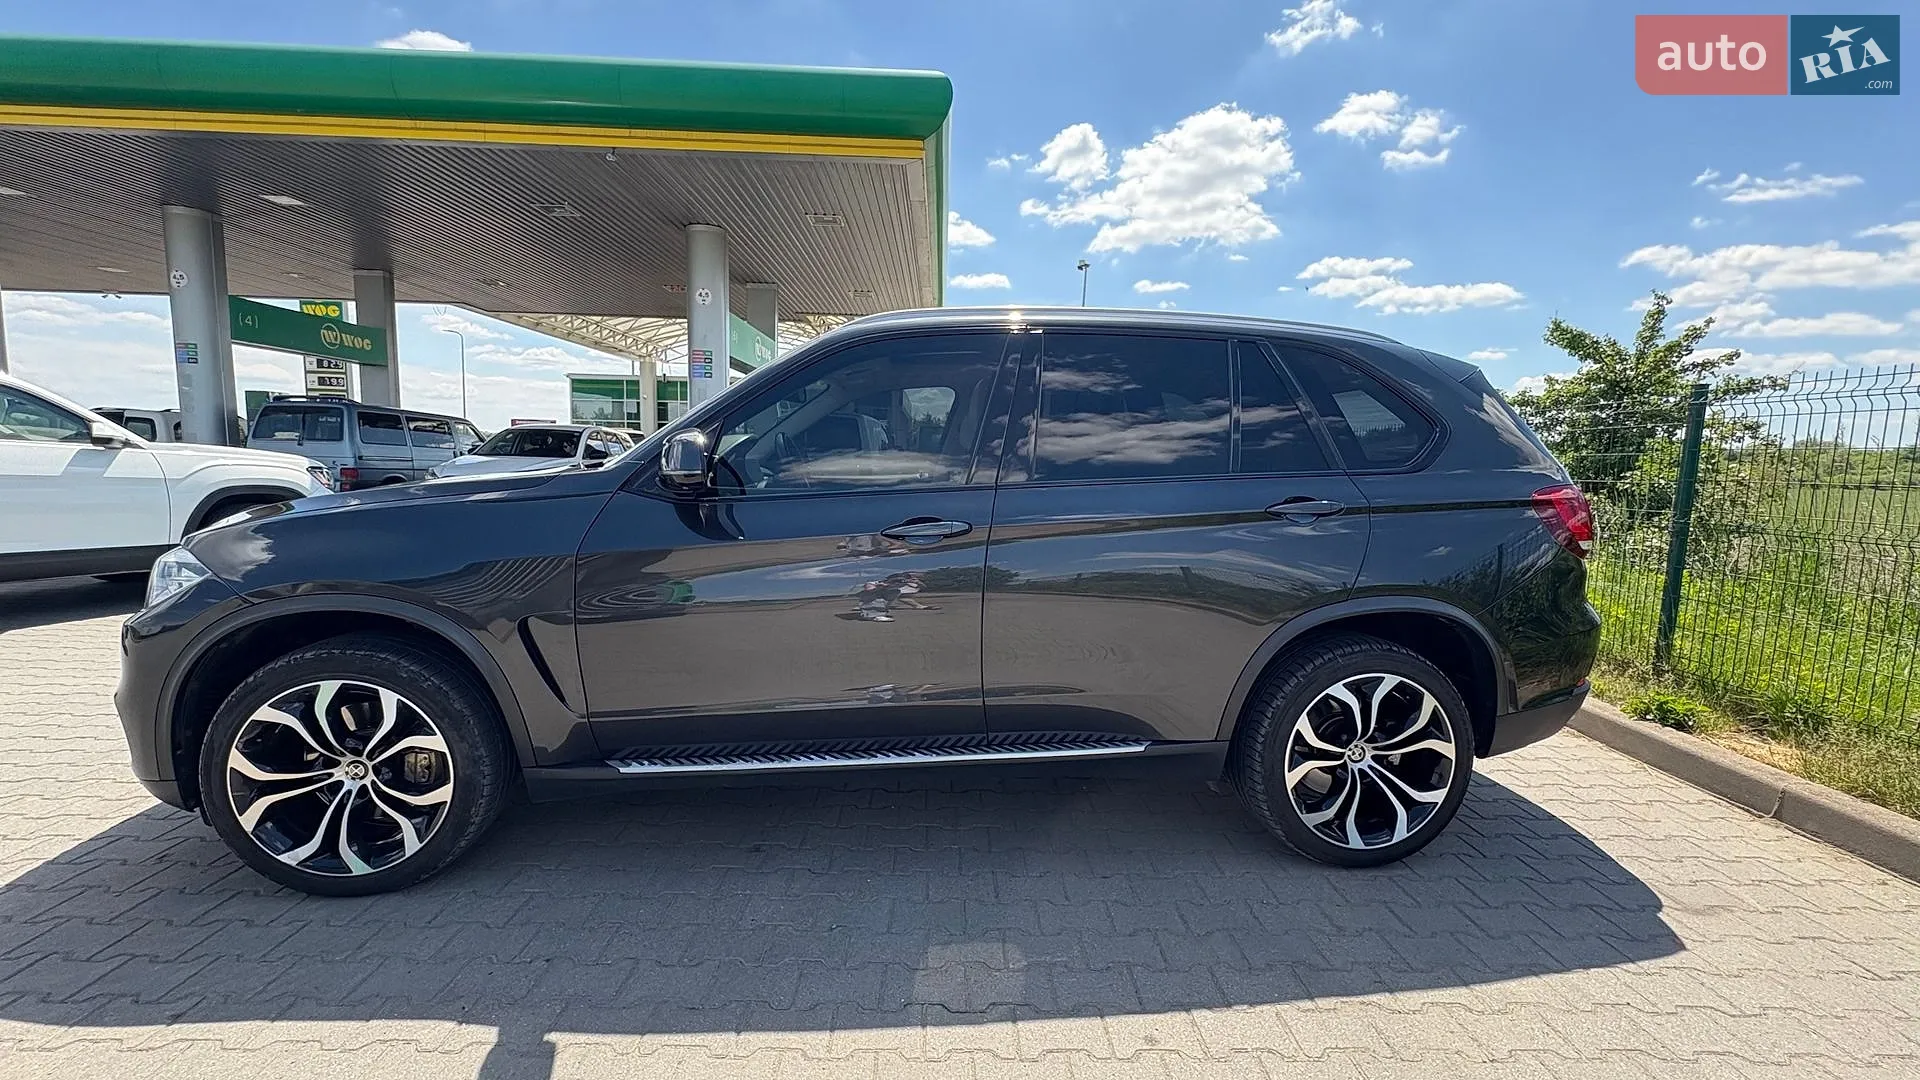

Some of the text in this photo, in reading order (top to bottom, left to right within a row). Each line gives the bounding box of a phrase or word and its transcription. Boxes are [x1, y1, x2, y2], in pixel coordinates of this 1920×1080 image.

[302, 304, 340, 317] WOG
[238, 312, 259, 329] (4)
[341, 332, 372, 351] WOG
